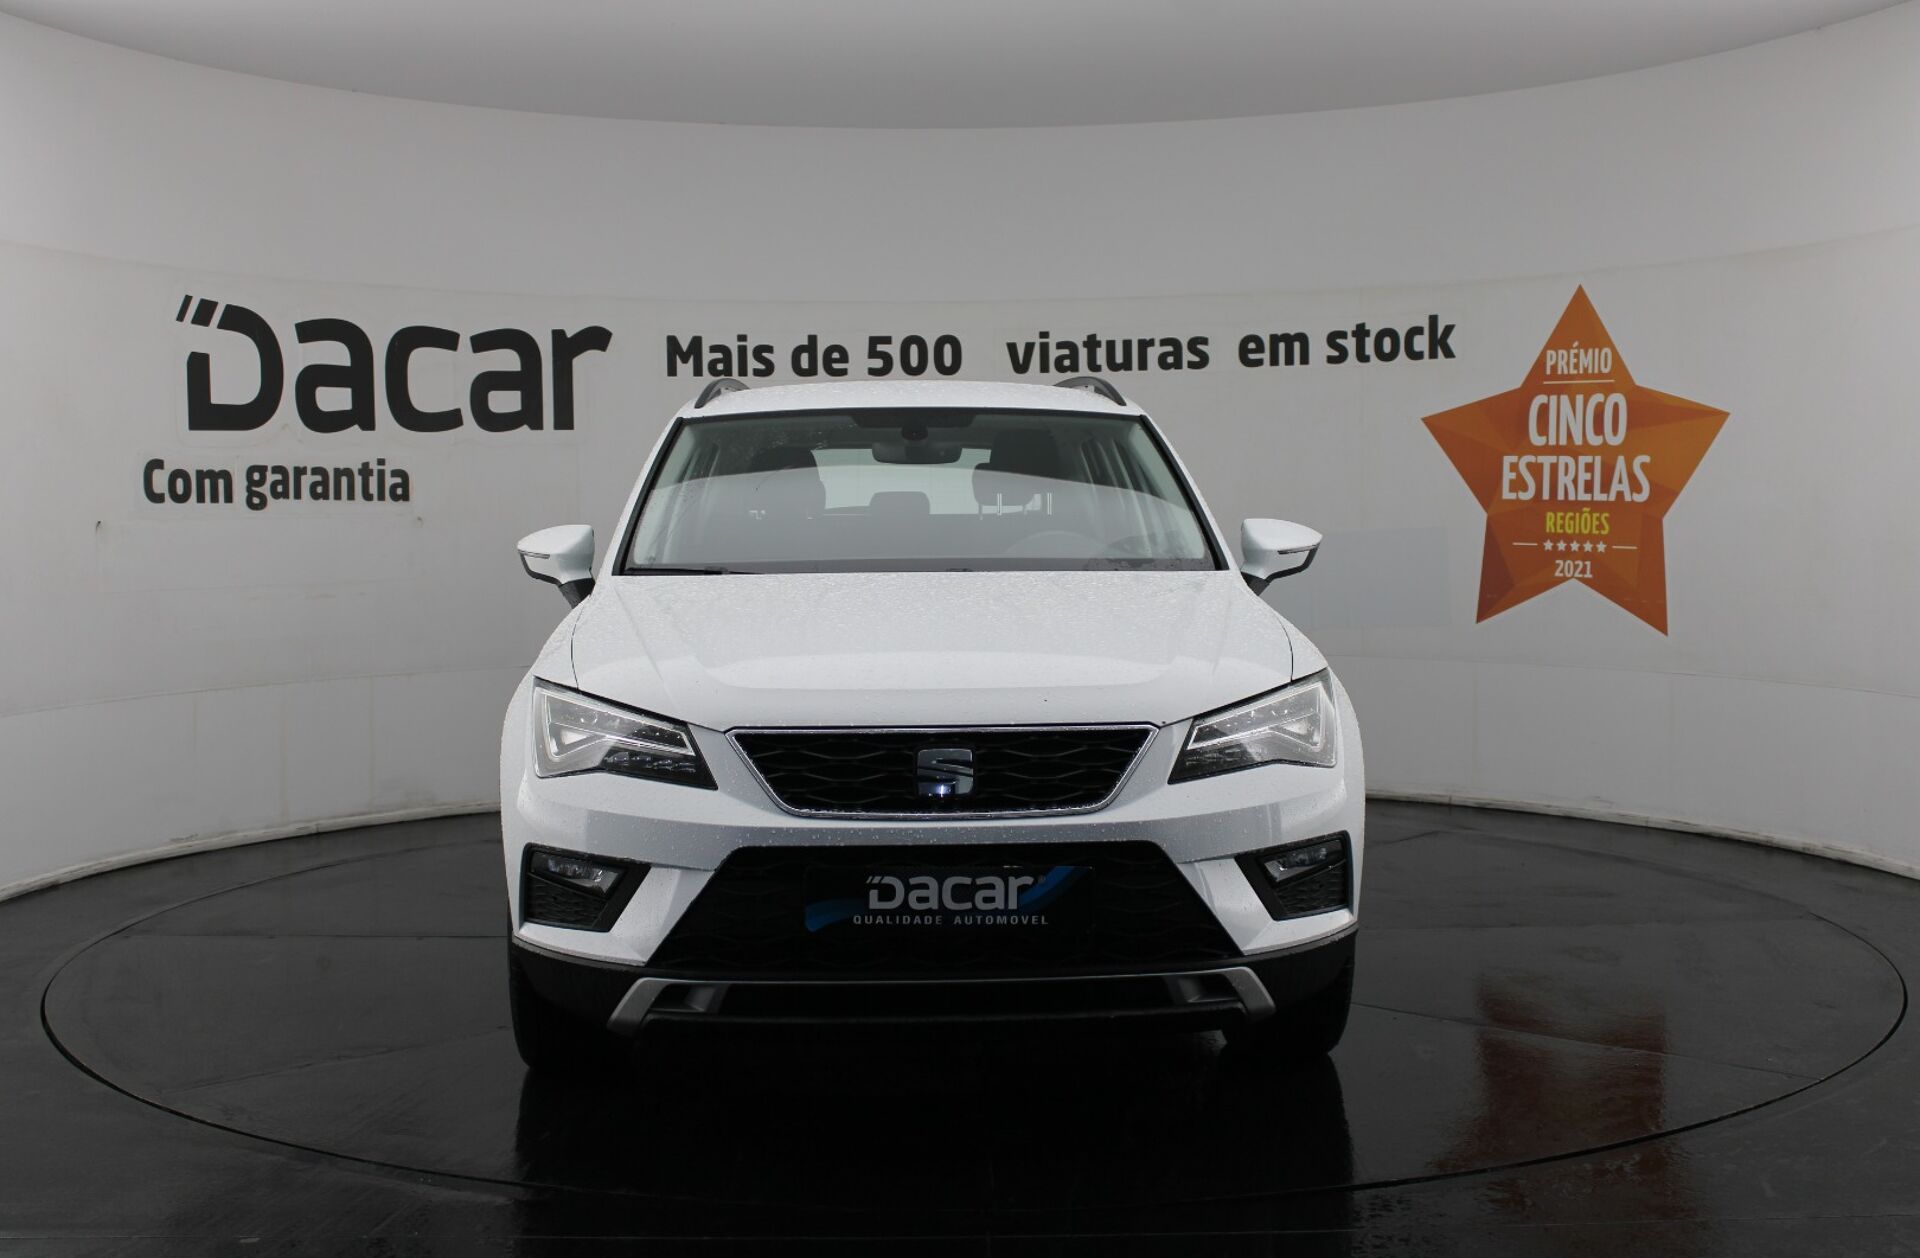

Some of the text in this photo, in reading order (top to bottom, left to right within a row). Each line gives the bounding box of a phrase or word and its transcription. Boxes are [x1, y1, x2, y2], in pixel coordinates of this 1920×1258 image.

[176, 295, 613, 433] Dacar
[665, 314, 1456, 377] Mais de 500 viaturas em stock
[1545, 341, 1613, 376] PRÉMIO
[1527, 392, 1628, 447] CINCO
[143, 457, 411, 511] Com garantia
[1502, 454, 1651, 503] ESTRELAS
[1545, 507, 1610, 535] REGIÕES
[1554, 559, 1593, 579] 2021
[866, 875, 1035, 911] Dacar
[853, 914, 943, 926] QUALIDADE
